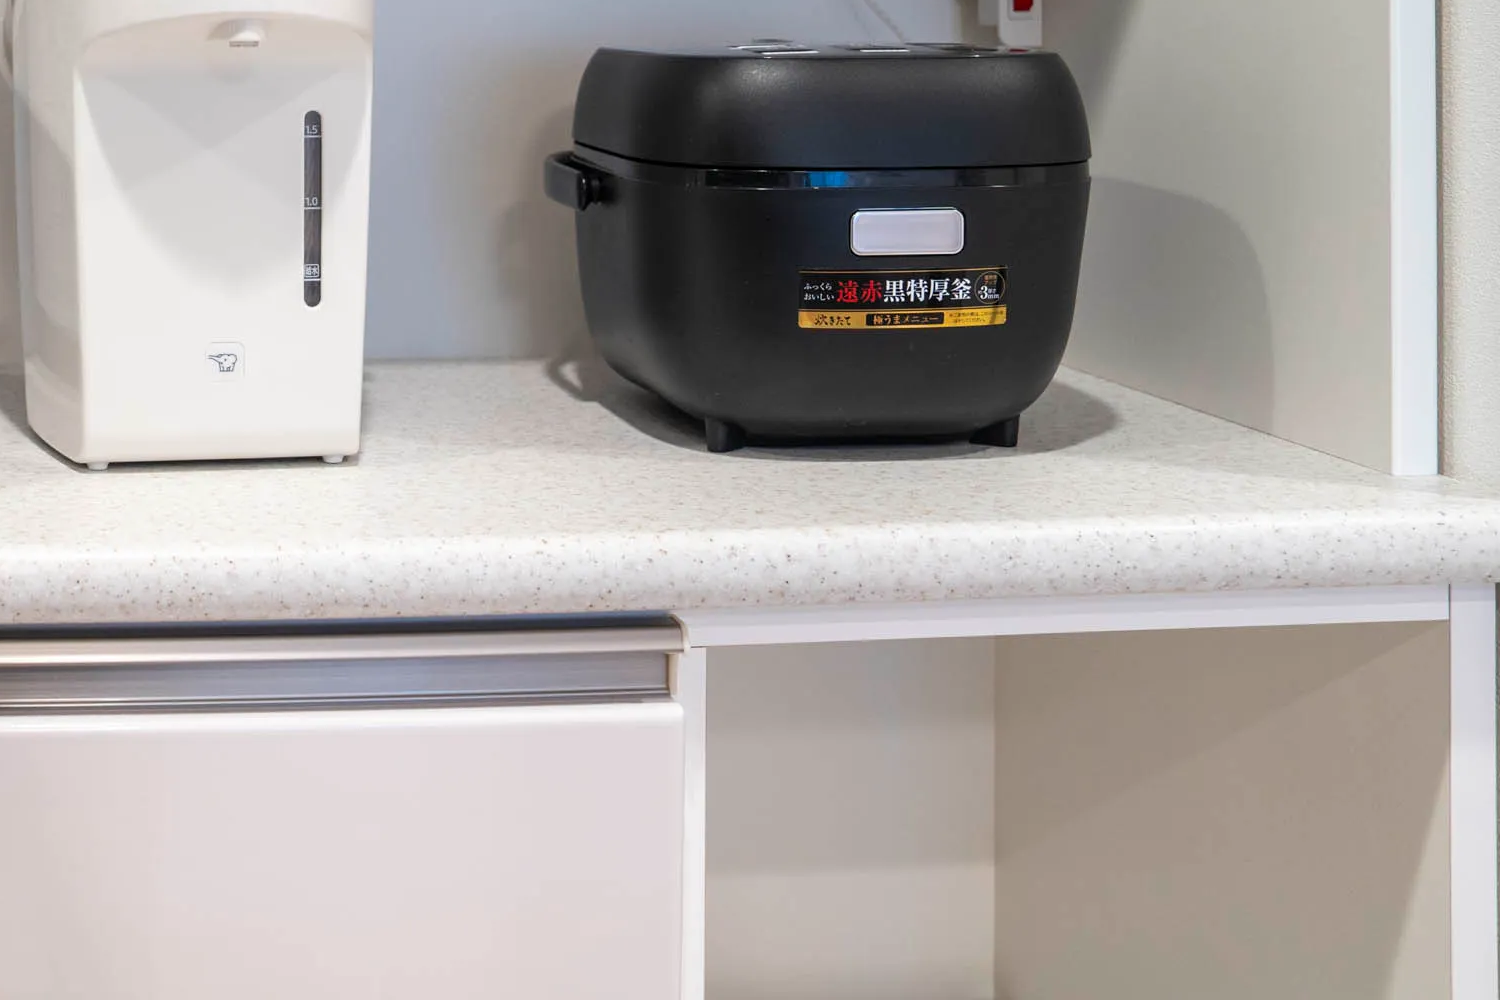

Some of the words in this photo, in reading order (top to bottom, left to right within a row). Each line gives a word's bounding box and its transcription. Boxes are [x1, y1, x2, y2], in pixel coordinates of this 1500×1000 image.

[305, 125, 318, 134] 1.5
[305, 197, 318, 206] 1.0
[803, 282, 832, 290] ふっくら
[803, 293, 835, 301] おいしい
[814, 313, 851, 326] 炊きたて
